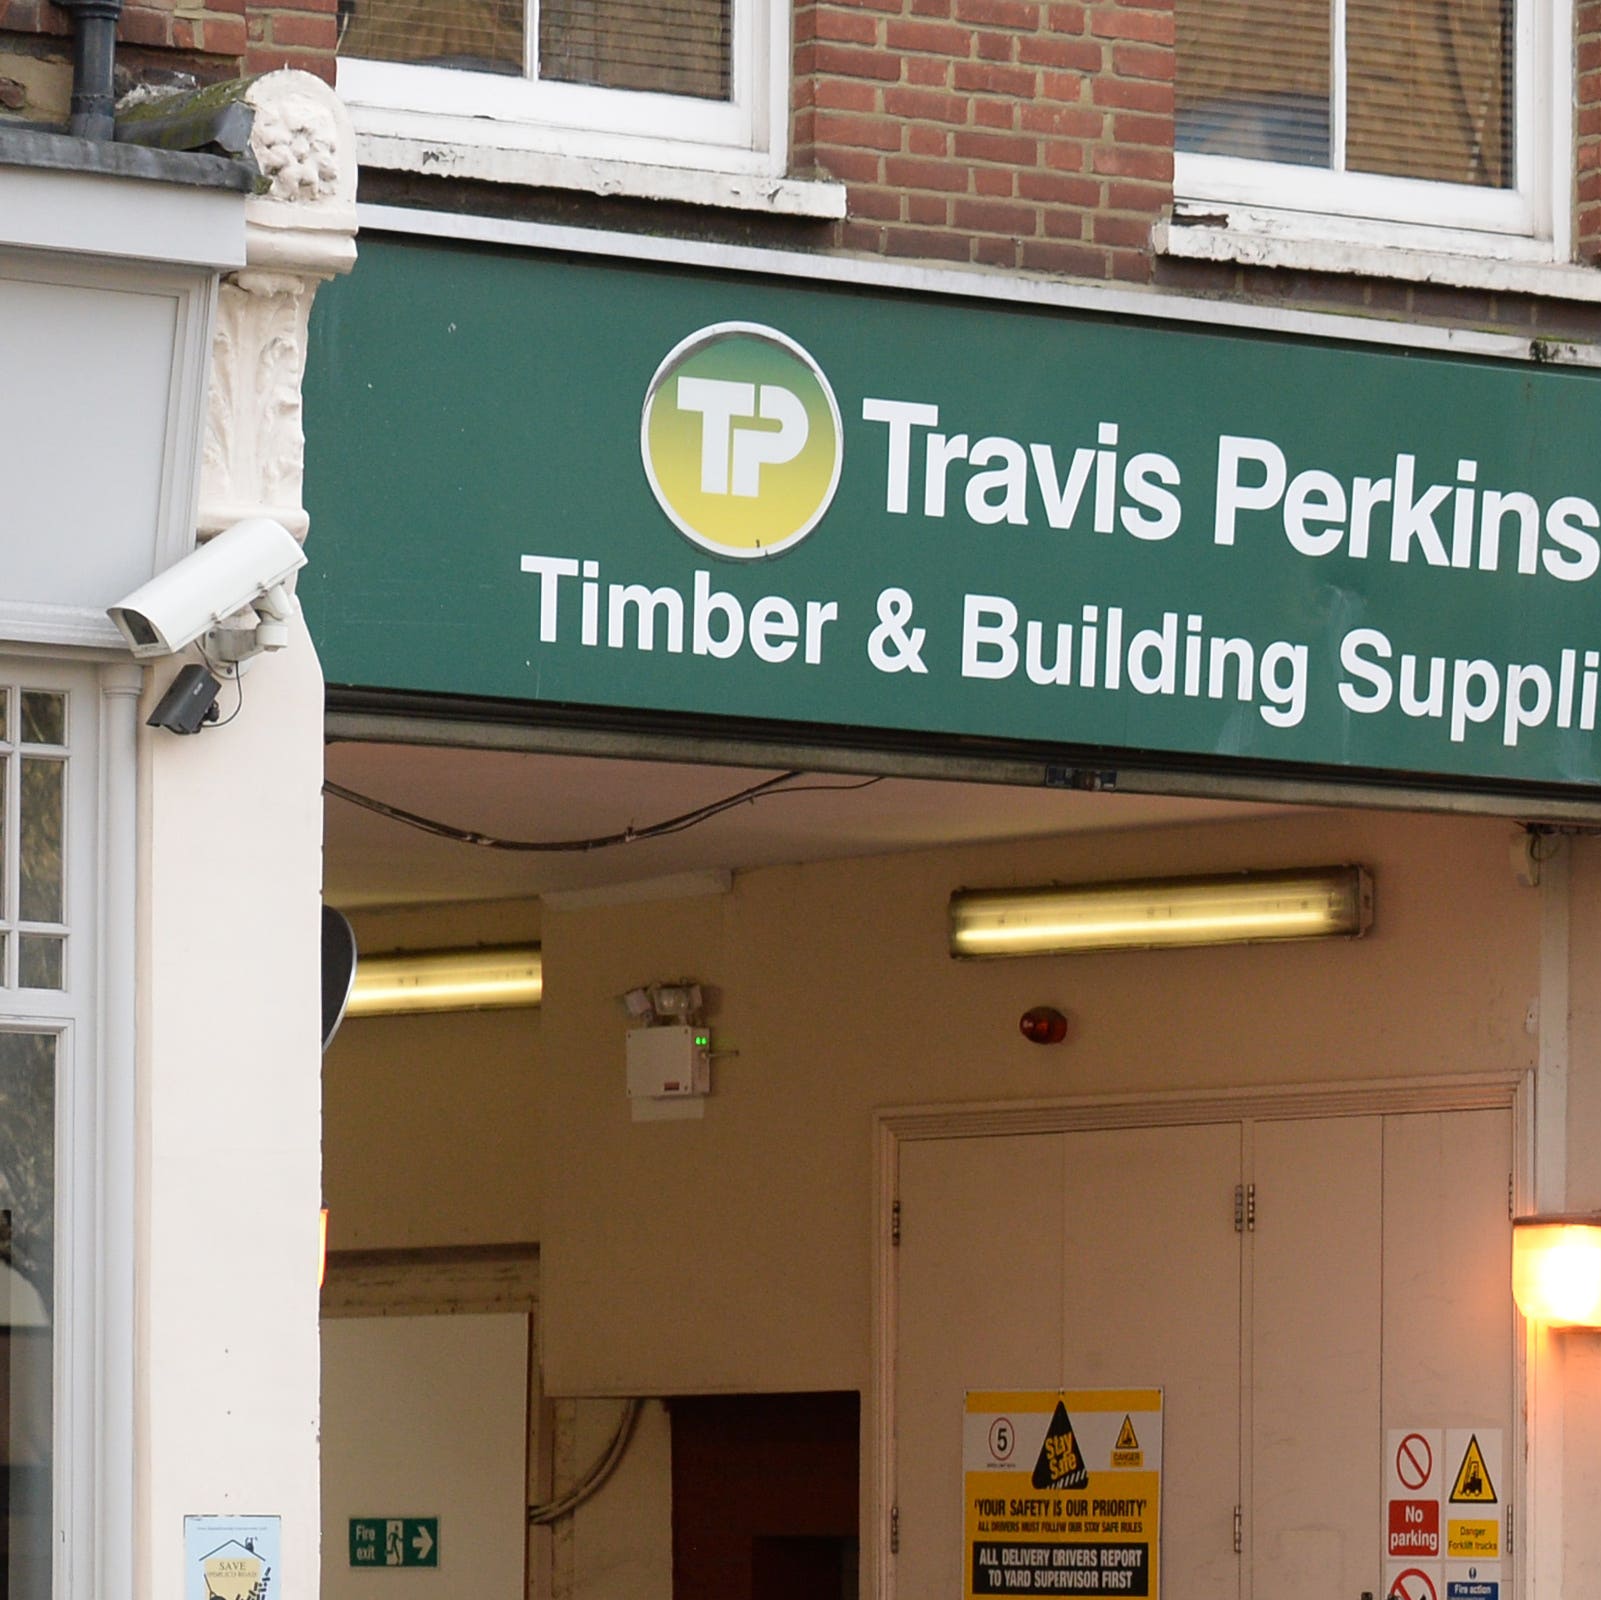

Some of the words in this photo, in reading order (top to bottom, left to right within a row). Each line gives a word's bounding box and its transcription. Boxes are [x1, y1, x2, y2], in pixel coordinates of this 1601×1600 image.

[677, 375, 806, 496] TP
[862, 398, 1181, 541] Travis
[1214, 434, 1601, 581] Perkins
[520, 554, 838, 665] Timber
[867, 586, 927, 672] &
[961, 595, 1308, 728] Building
[997, 1428, 1007, 1451] 5
[1045, 1432, 1072, 1459] Stay
[1010, 1500, 1049, 1517] SAFETY
[1053, 1501, 1061, 1516] IS
[1066, 1500, 1088, 1516] OUR
[1405, 1506, 1423, 1522] No
[356, 1525, 375, 1541] Fire
[1391, 1530, 1437, 1550] parking
[1460, 1526, 1486, 1538] Danger
[356, 1547, 375, 1561] exit
[1449, 1541, 1473, 1550] Forklift
[1475, 1541, 1497, 1550] trucks
[979, 1548, 998, 1565] ALL
[1002, 1549, 1050, 1566] DELIVERY
[1053, 1549, 1097, 1566] DRIVERS
[1101, 1549, 1142, 1567] REPORT
[219, 1562, 246, 1571] SAVE
[988, 1570, 1001, 1587] TO
[1005, 1570, 1031, 1587] YARD
[1034, 1570, 1098, 1588] SUPERVISOR
[1102, 1571, 1133, 1588] FIRST
[1454, 1584, 1468, 1594] Fire
[1470, 1584, 1491, 1594] action
